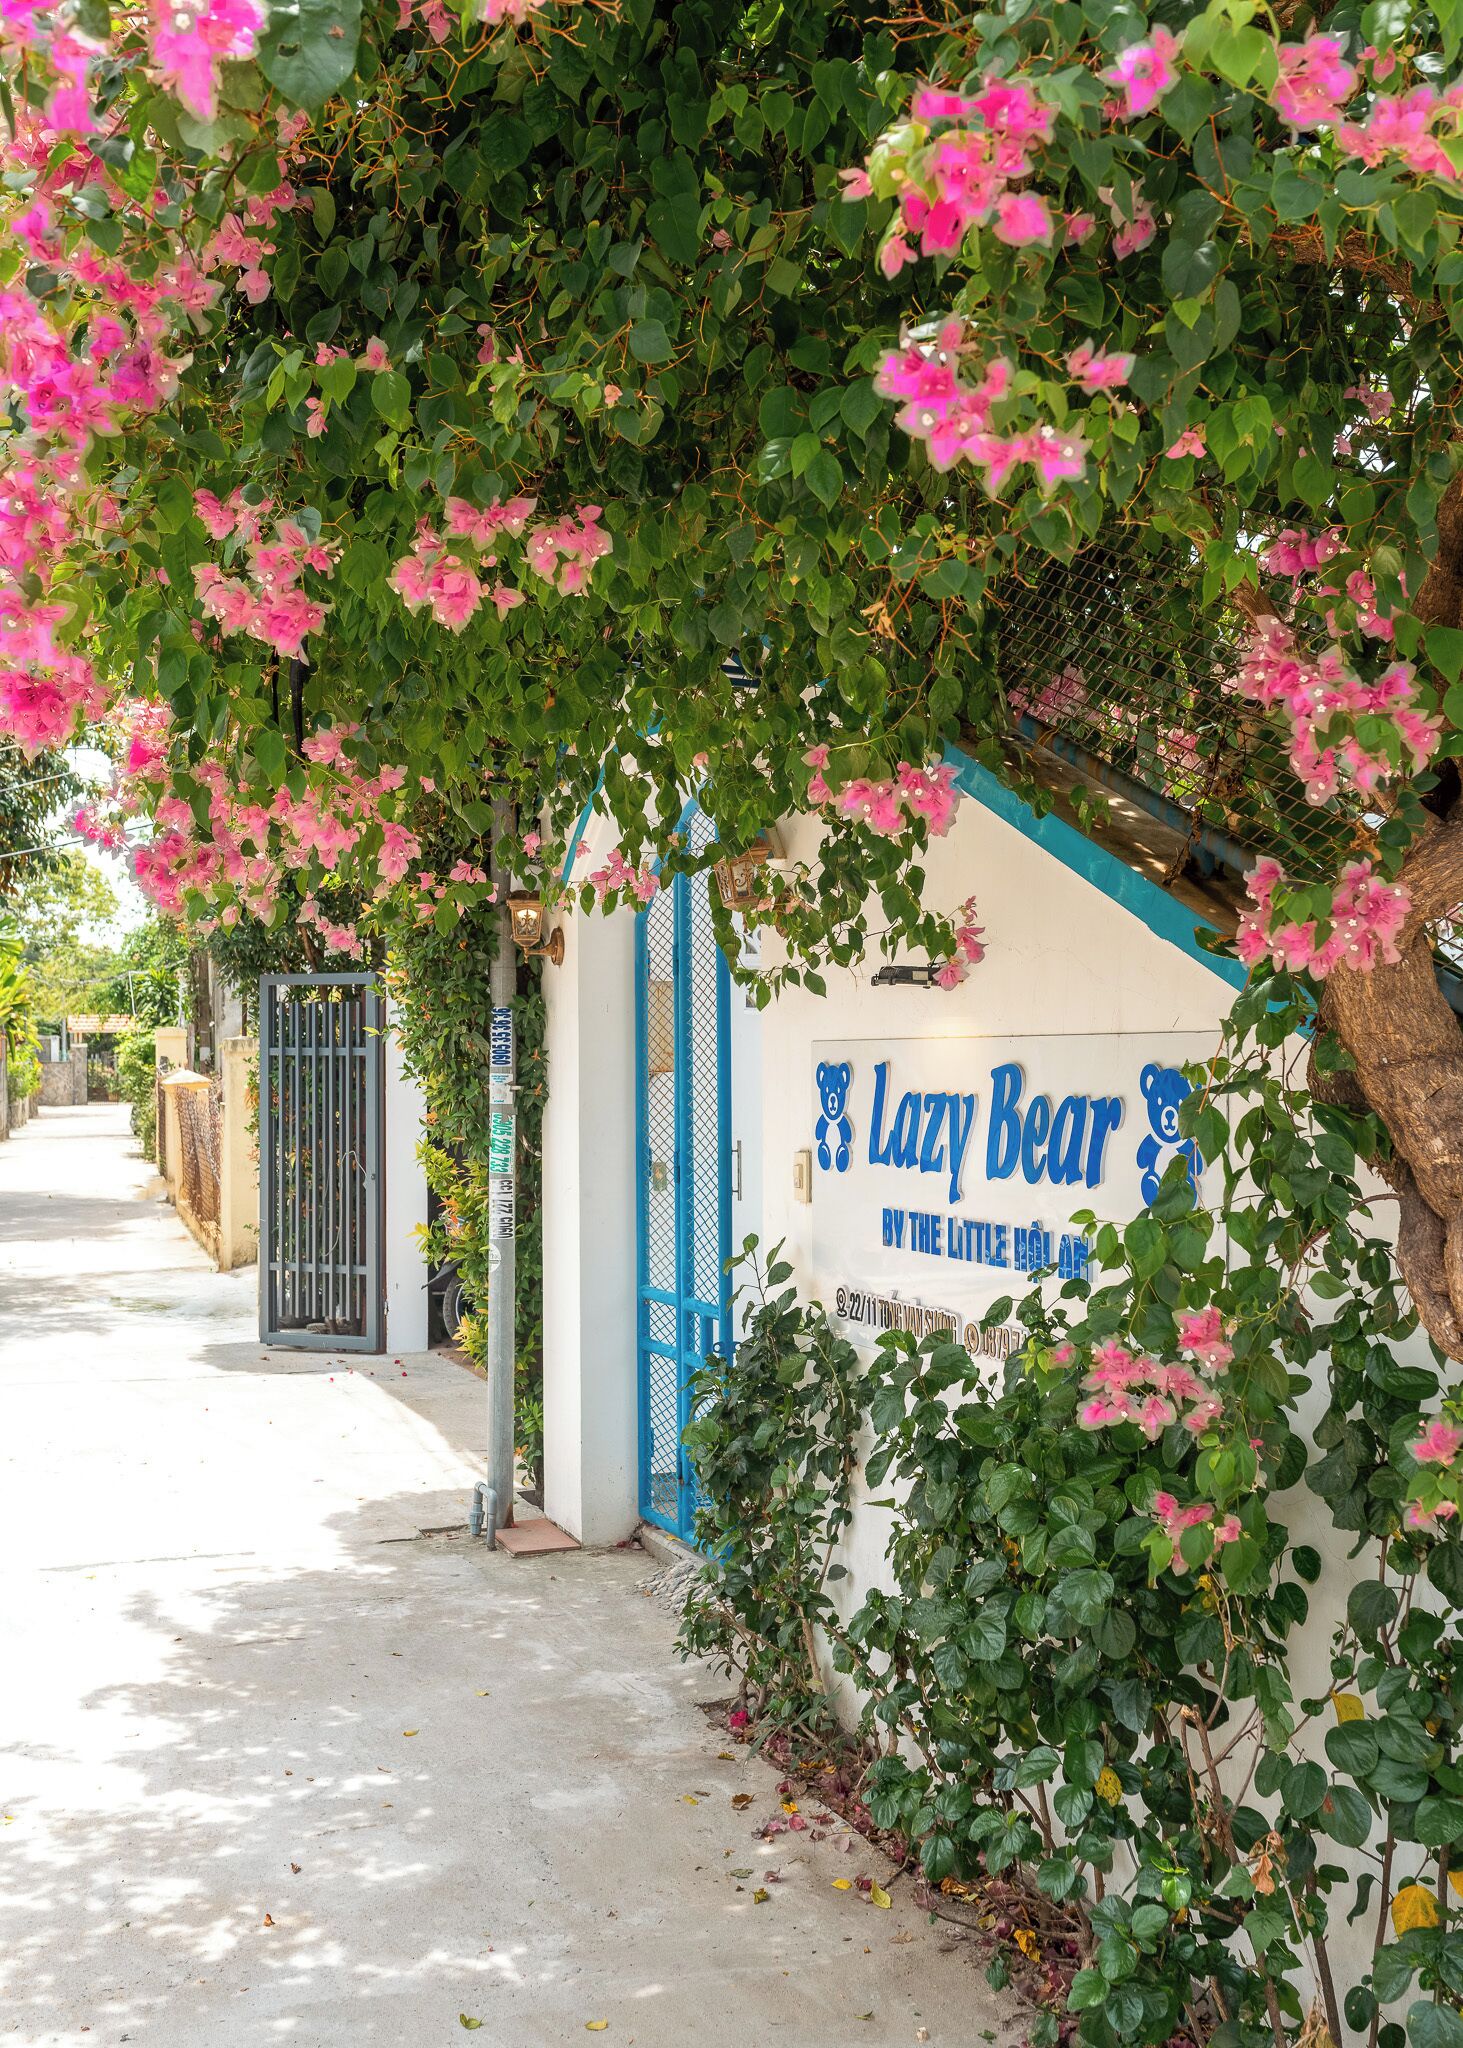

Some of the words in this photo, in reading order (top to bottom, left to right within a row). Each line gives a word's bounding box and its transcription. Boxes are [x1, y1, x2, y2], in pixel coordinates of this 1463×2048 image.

[868, 1061, 977, 1204] Lazy
[986, 1063, 1122, 1189] Bear
[882, 1208, 905, 1249] BY
[909, 1212, 941, 1256] THE
[1058, 1234, 1089, 1283] AN
[849, 1292, 877, 1326] 22/11
